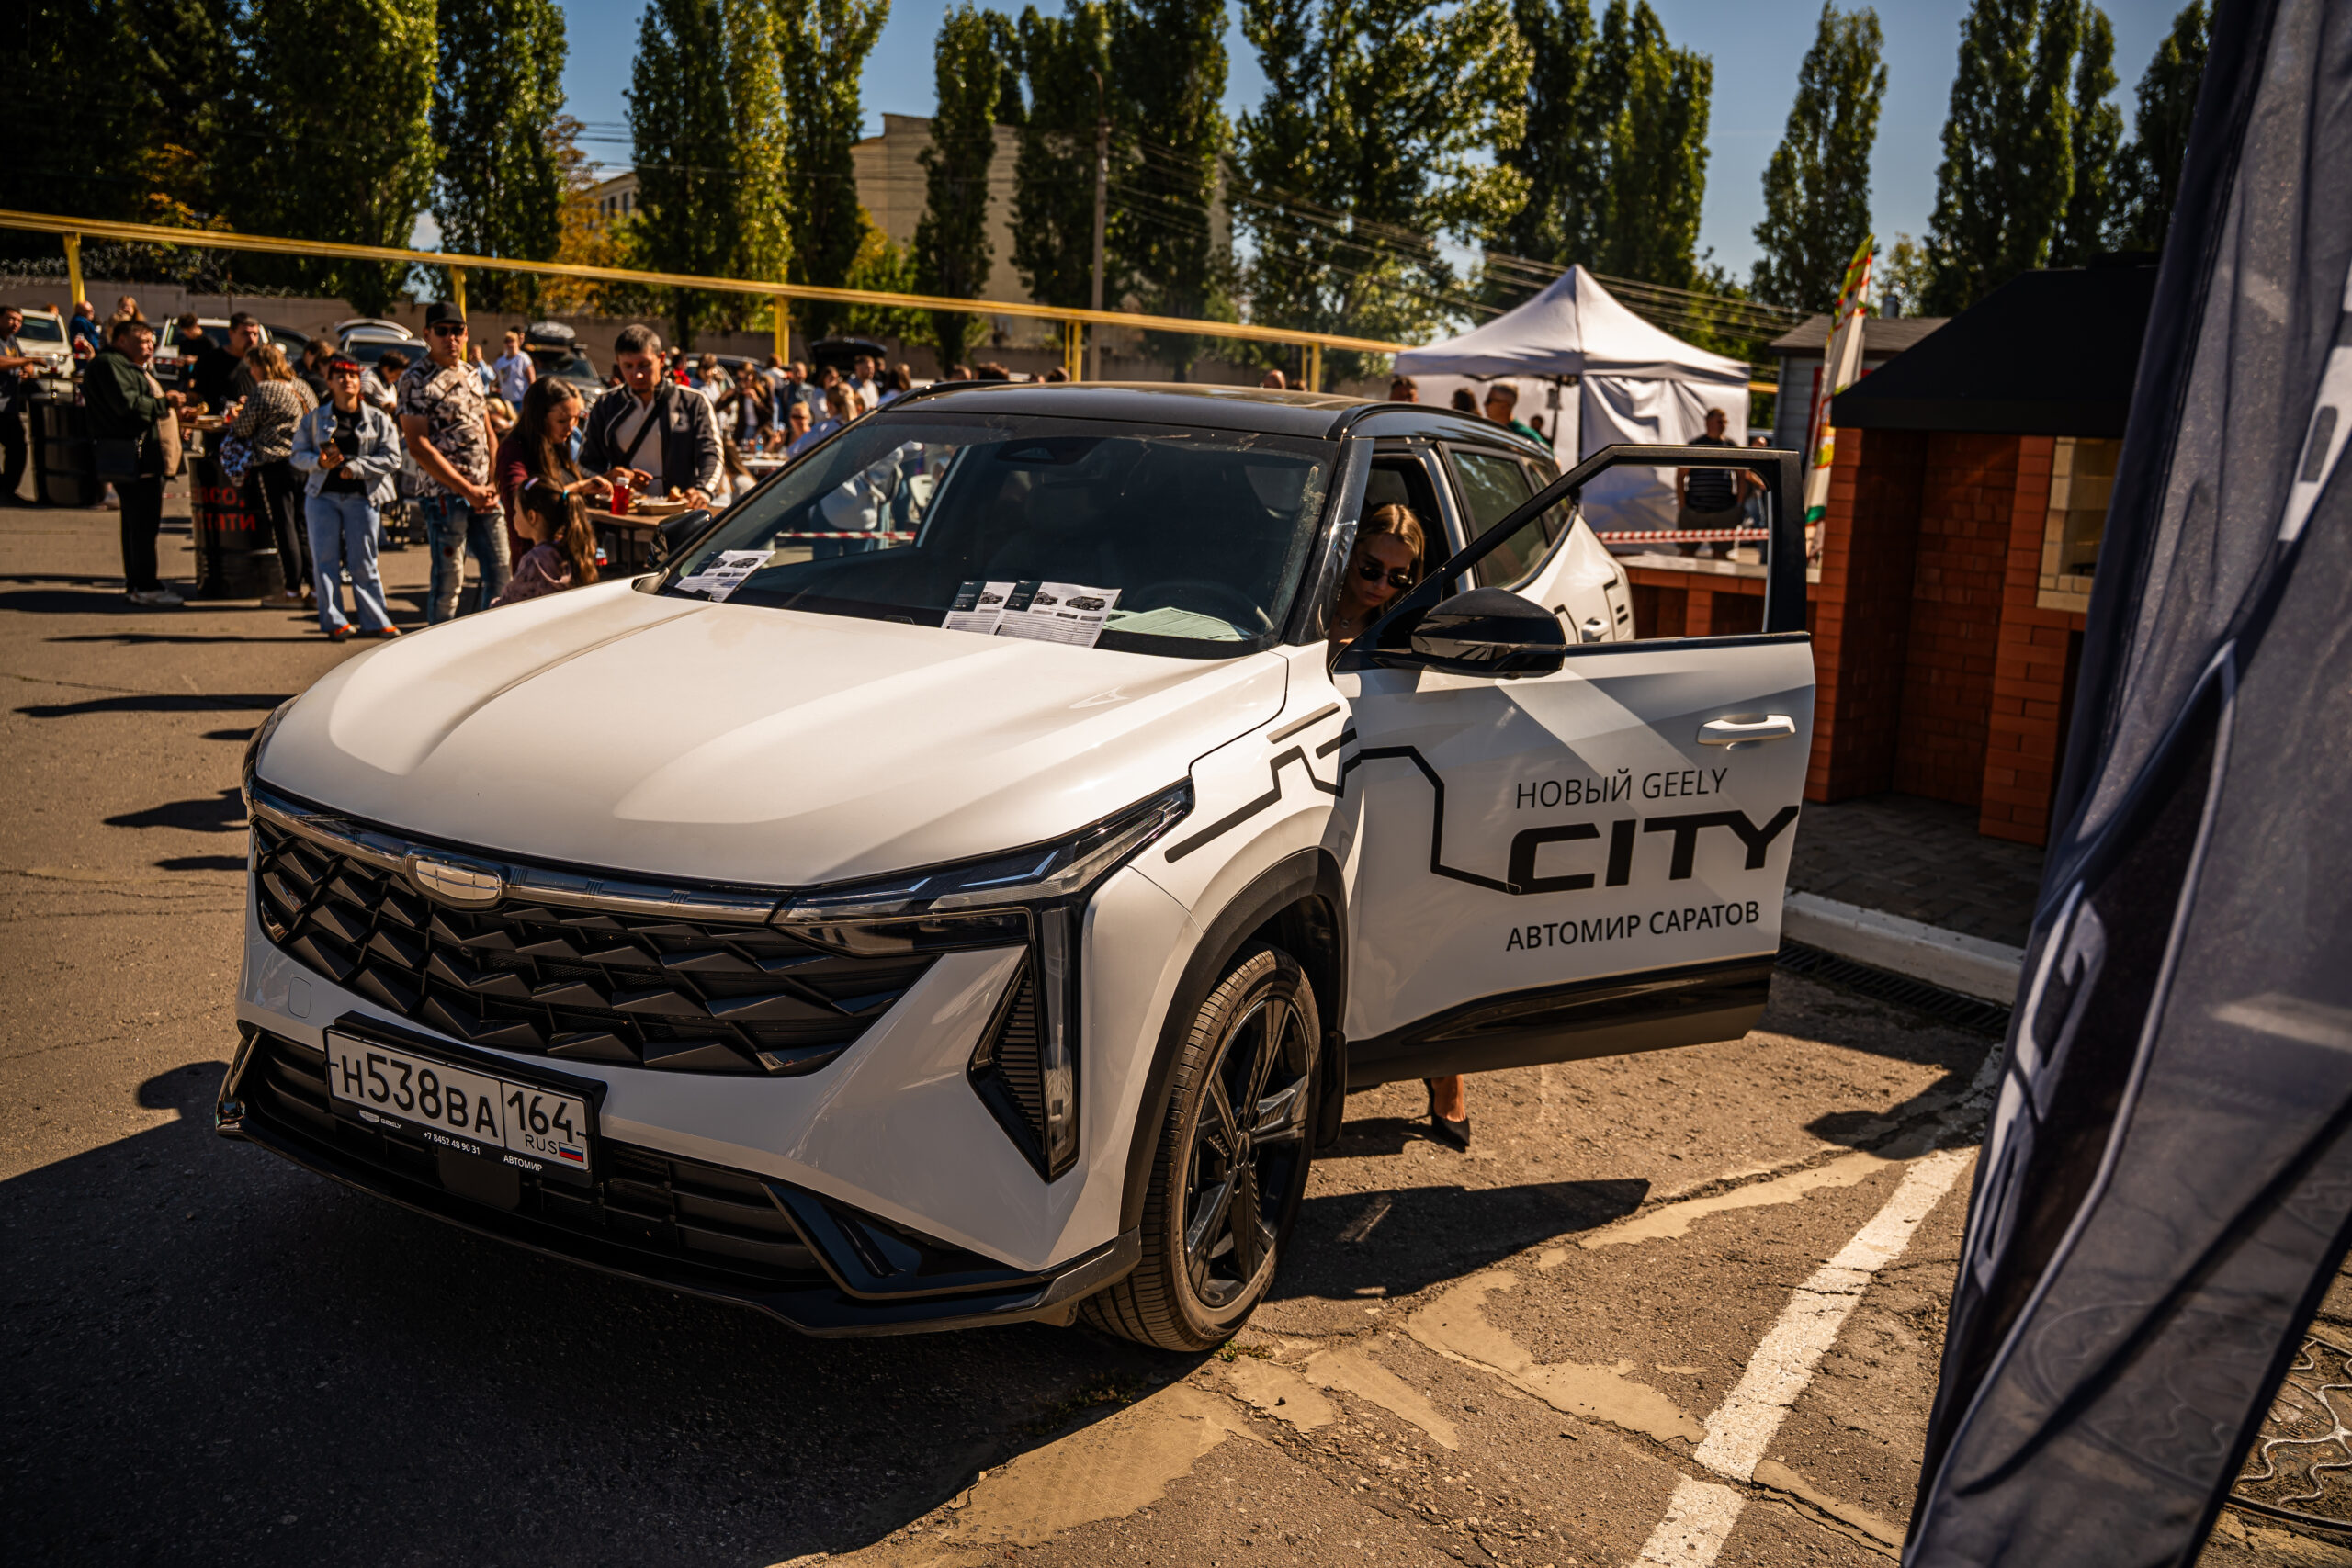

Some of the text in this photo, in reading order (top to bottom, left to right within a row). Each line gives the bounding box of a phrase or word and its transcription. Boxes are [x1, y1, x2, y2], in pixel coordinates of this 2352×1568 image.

[1516, 768, 1728, 809] НОВЫЙ GEELY
[1507, 805, 1800, 897] CITY
[1506, 900, 1760, 952] АВТОМИР САРАТОВ
[380, 1118, 402, 1130] GEELY
[506, 1090, 574, 1143] 164
[423, 1131, 481, 1156] +7 8452 48 90 31
[525, 1134, 558, 1156] RUS
[503, 1154, 543, 1173] АВТОМИР
